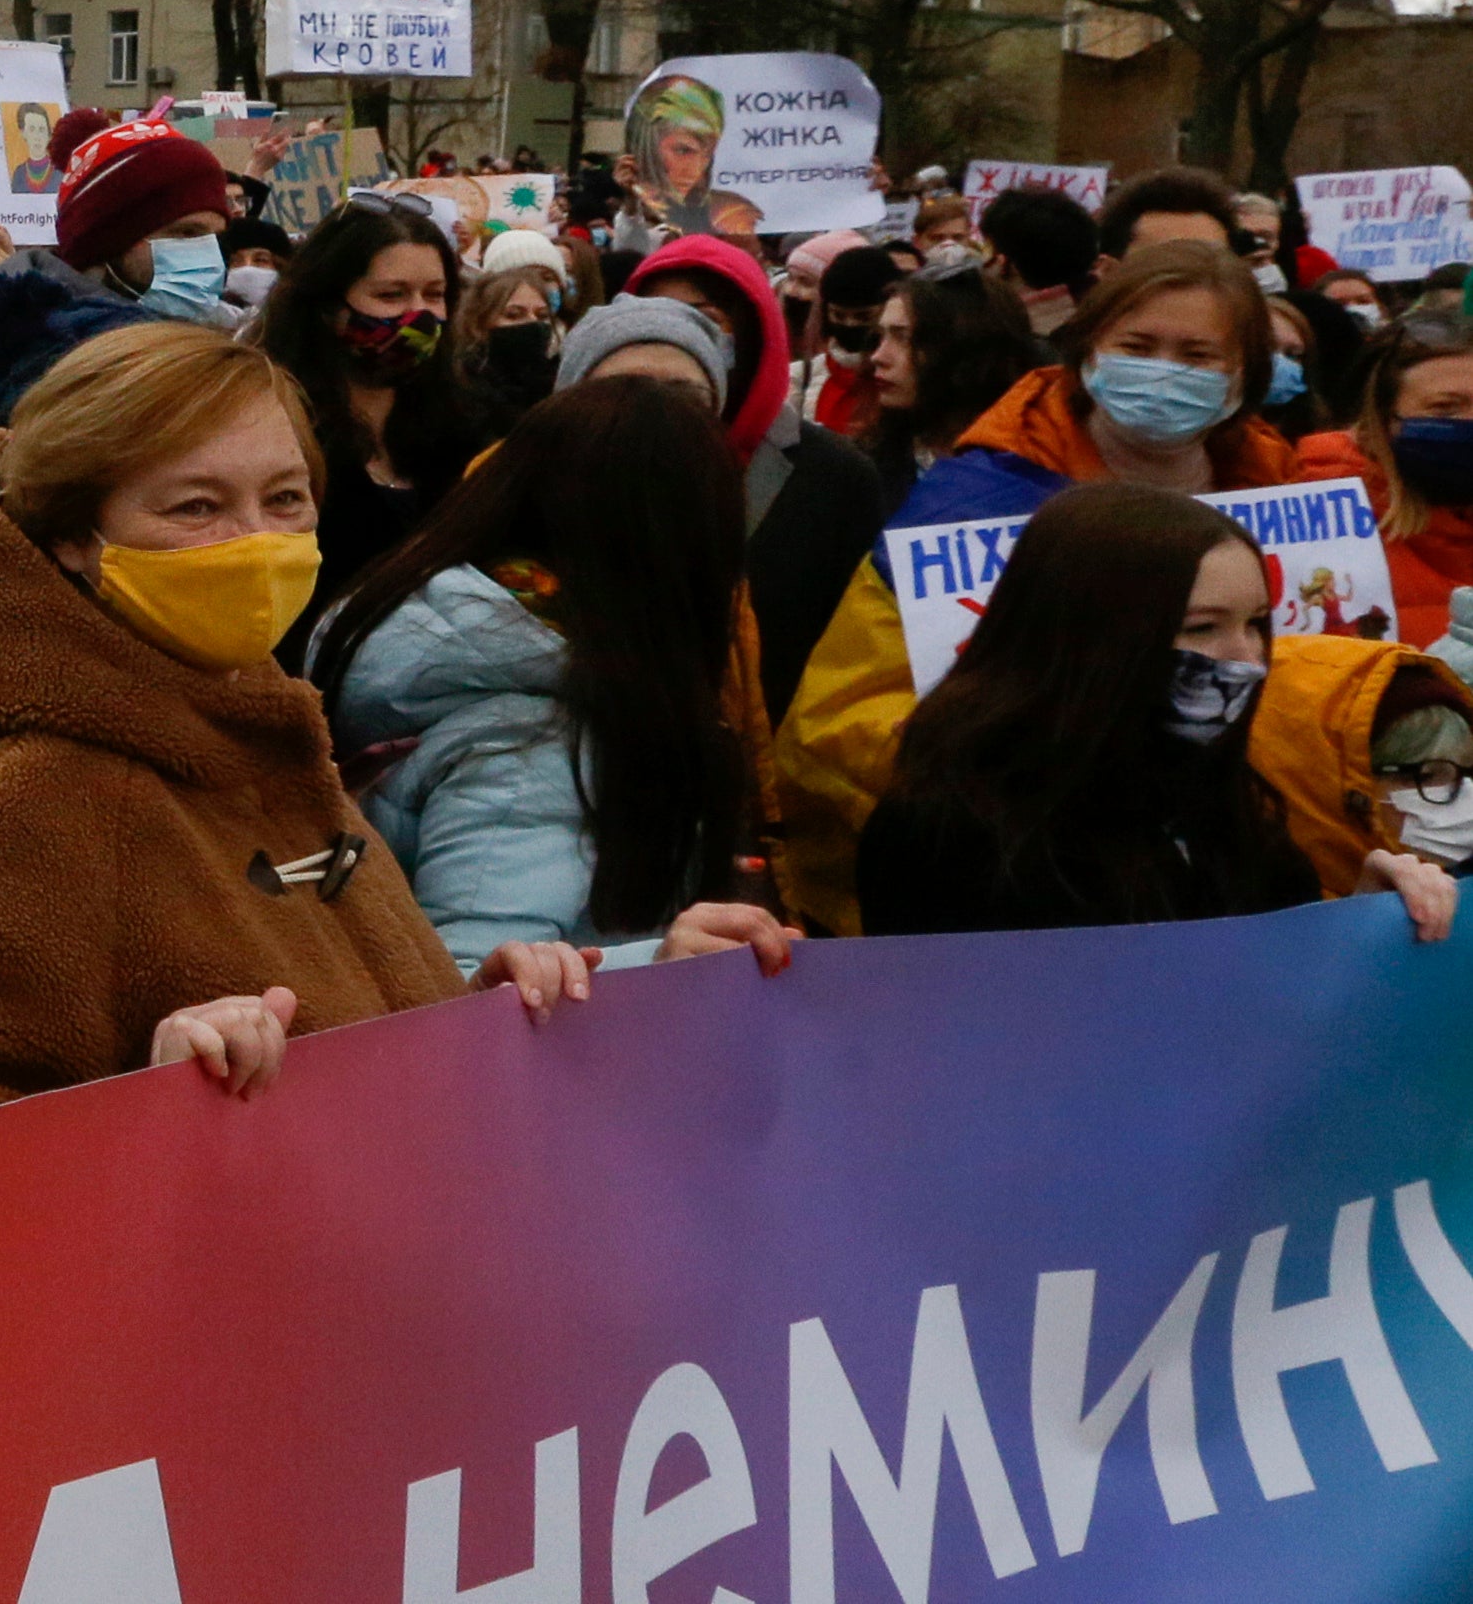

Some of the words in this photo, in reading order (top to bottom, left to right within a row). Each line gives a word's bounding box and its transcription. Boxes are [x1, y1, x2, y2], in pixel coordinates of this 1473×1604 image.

[300, 12, 335, 35] МЫ
[352, 13, 379, 39] НЕ
[313, 41, 447, 69] КРОВЕЙ
[735, 90, 849, 113] КОЖНА
[742, 125, 842, 147] ЖІНКА
[717, 163, 869, 185] СУПЕРГЕРОЇНЯ
[976, 166, 1105, 202] ЖІНКА
